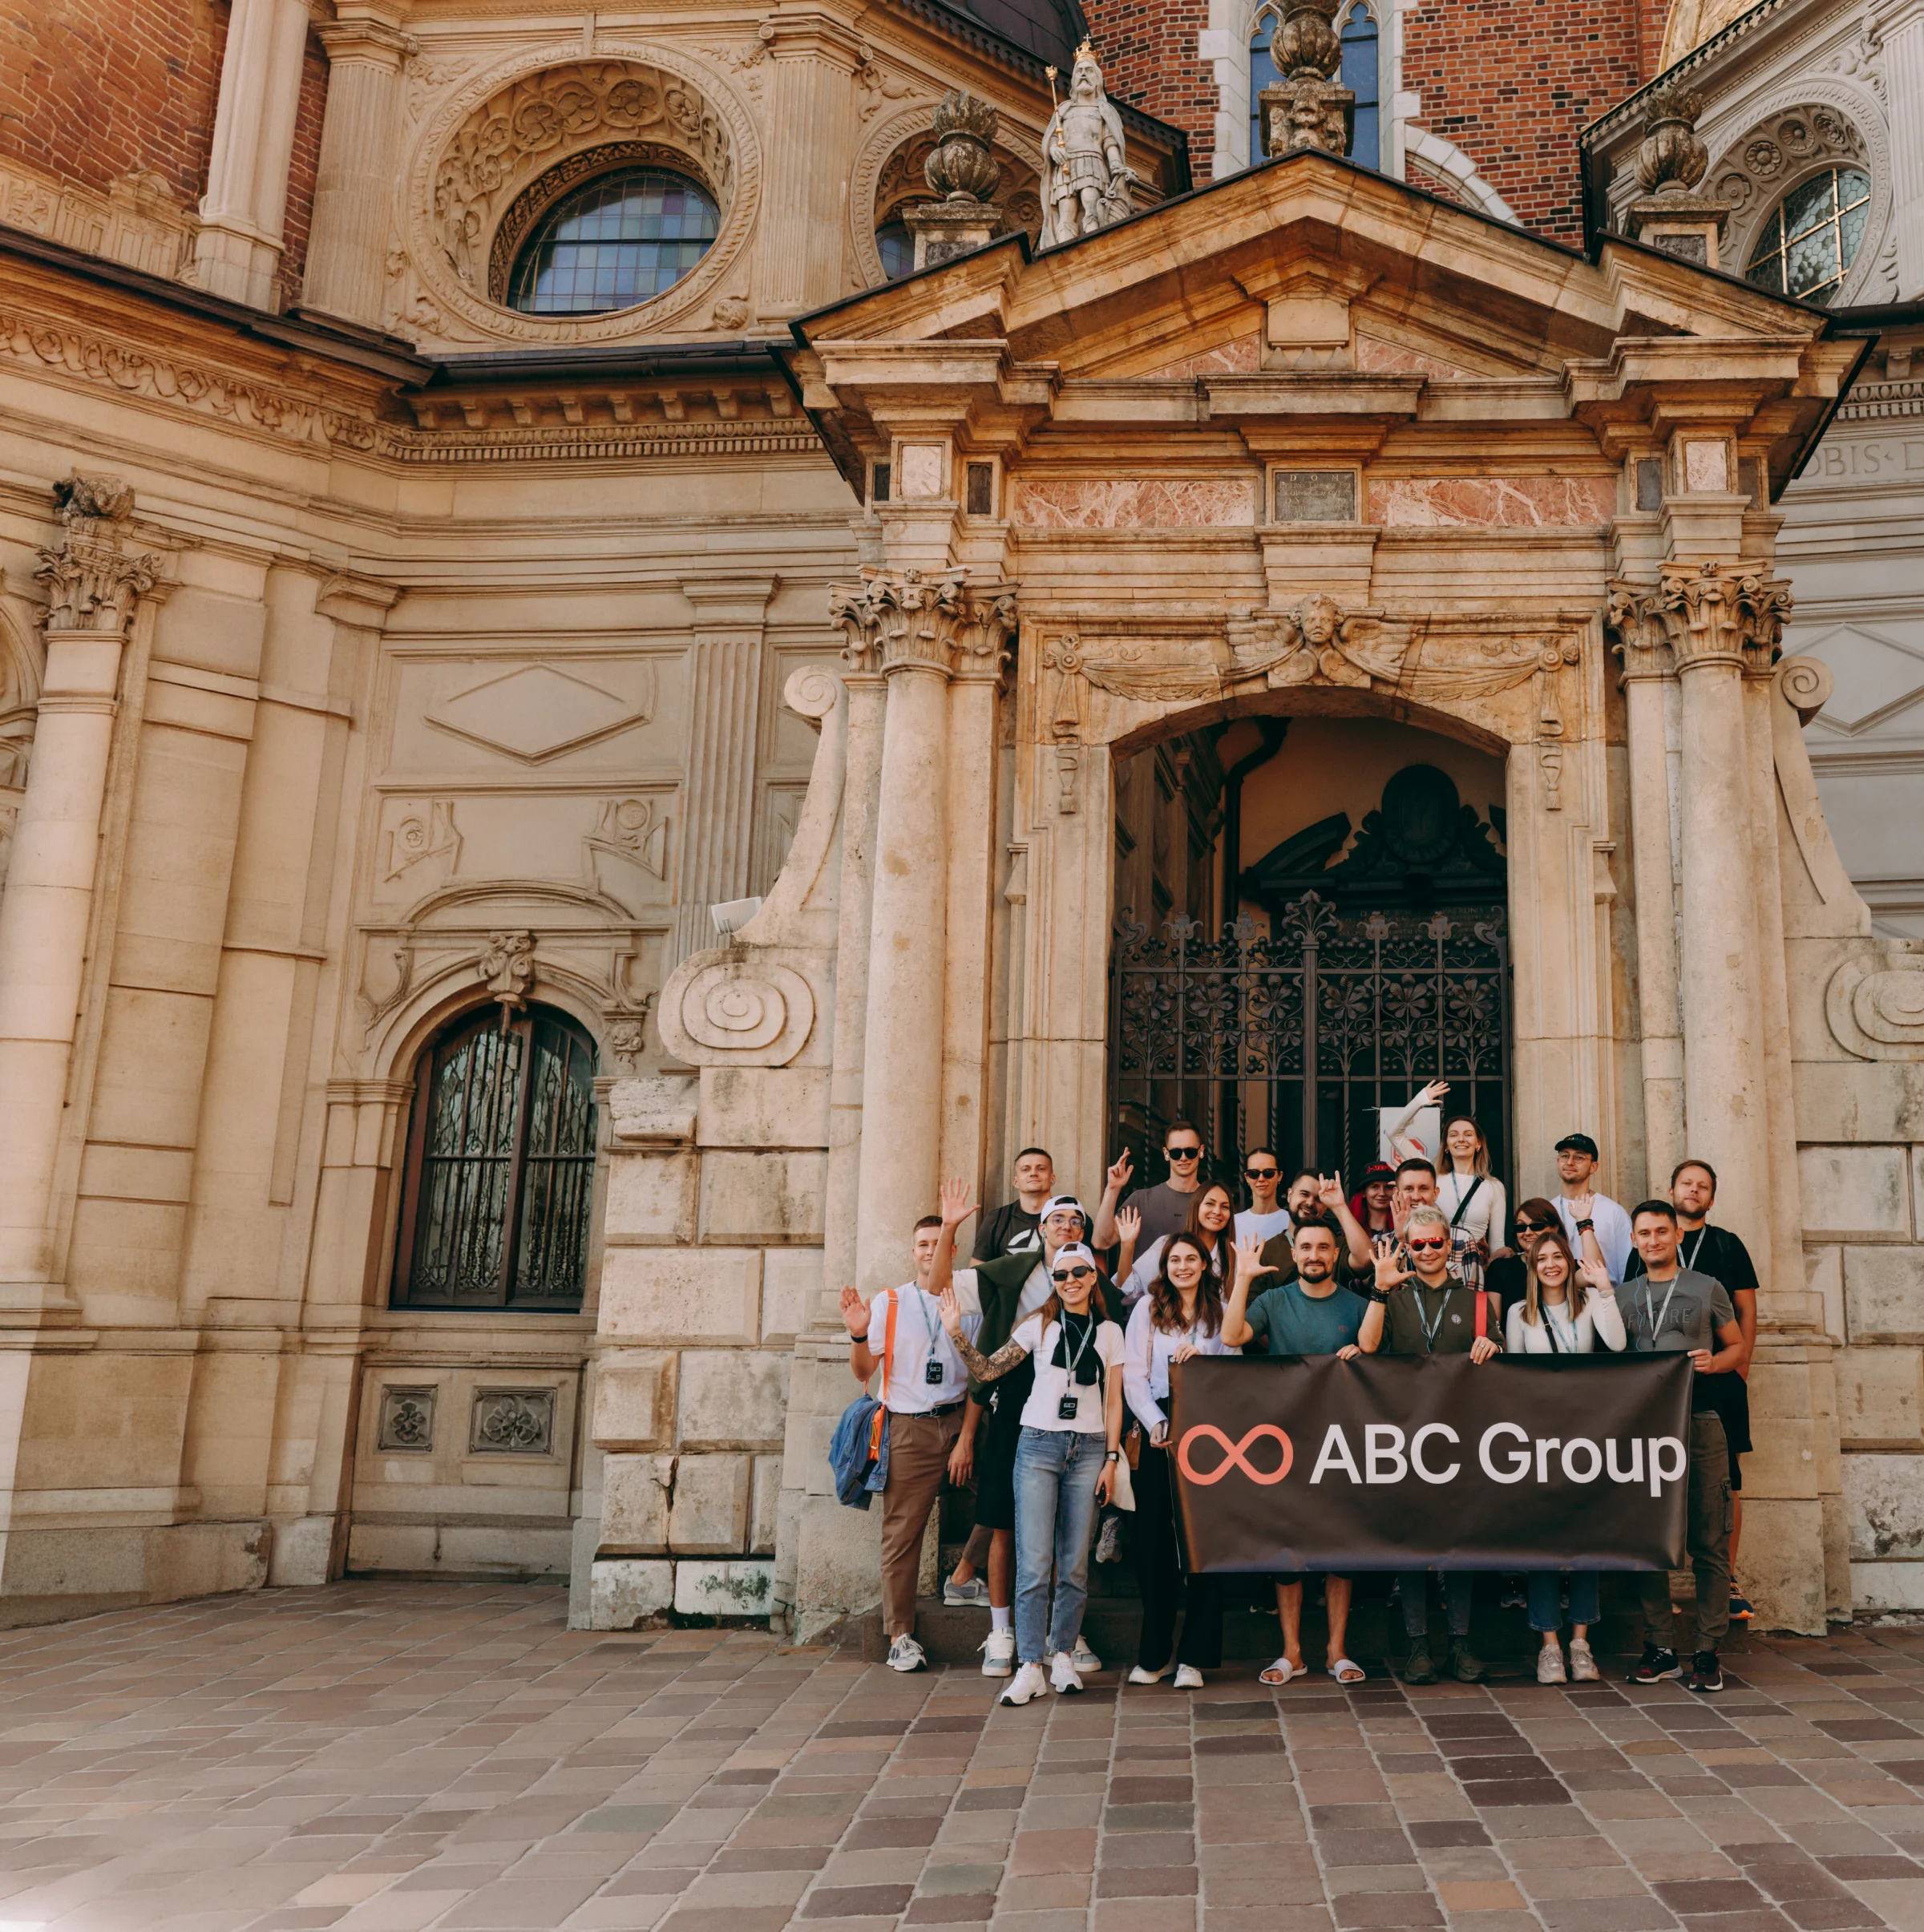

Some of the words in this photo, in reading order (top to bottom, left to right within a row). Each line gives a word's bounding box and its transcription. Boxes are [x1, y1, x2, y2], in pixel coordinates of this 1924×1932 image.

[1627, 1308, 1692, 1329] FUURE
[1308, 1422, 1461, 1485] ABC
[1478, 1421, 1687, 1498] Group
